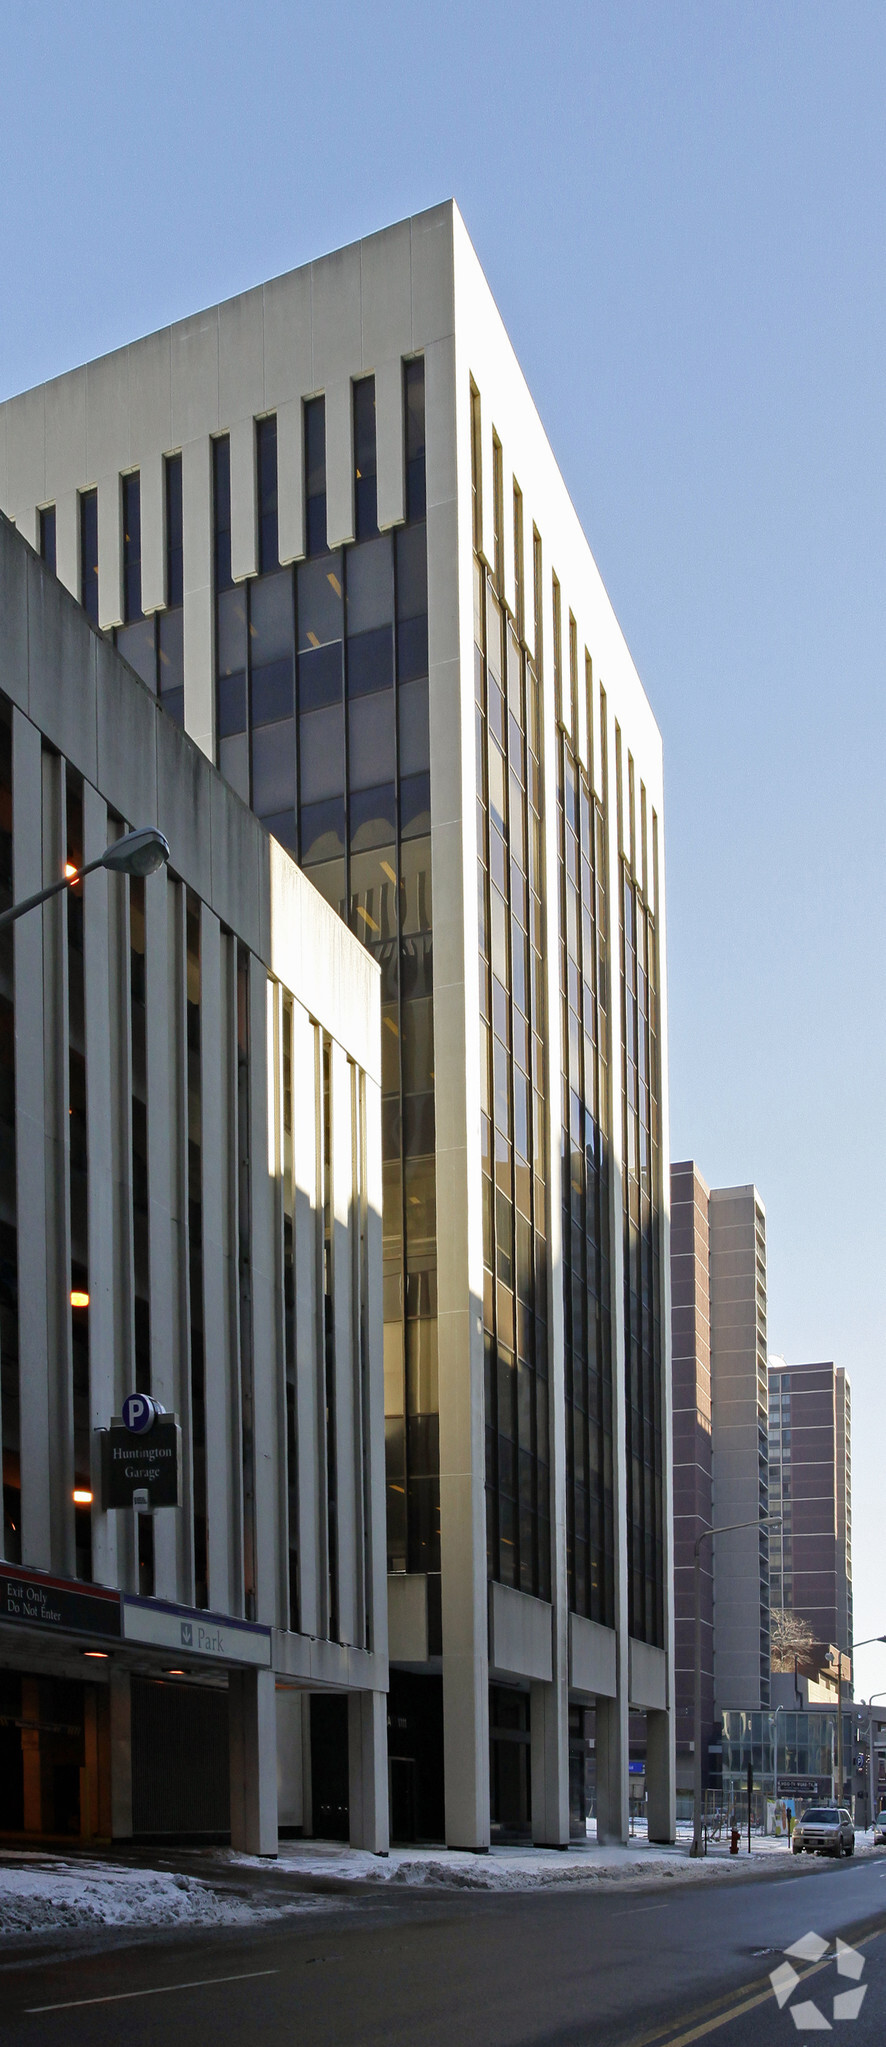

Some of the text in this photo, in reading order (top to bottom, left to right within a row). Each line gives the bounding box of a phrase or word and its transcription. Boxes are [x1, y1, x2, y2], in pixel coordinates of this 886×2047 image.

[128, 1399, 145, 1428] P
[113, 1447, 172, 1462] Huntington
[124, 1465, 160, 1481] Garage
[7, 1582, 48, 1606] Exit Only
[7, 1599, 62, 1622] Do Not Enter
[198, 1627, 225, 1653] Park
